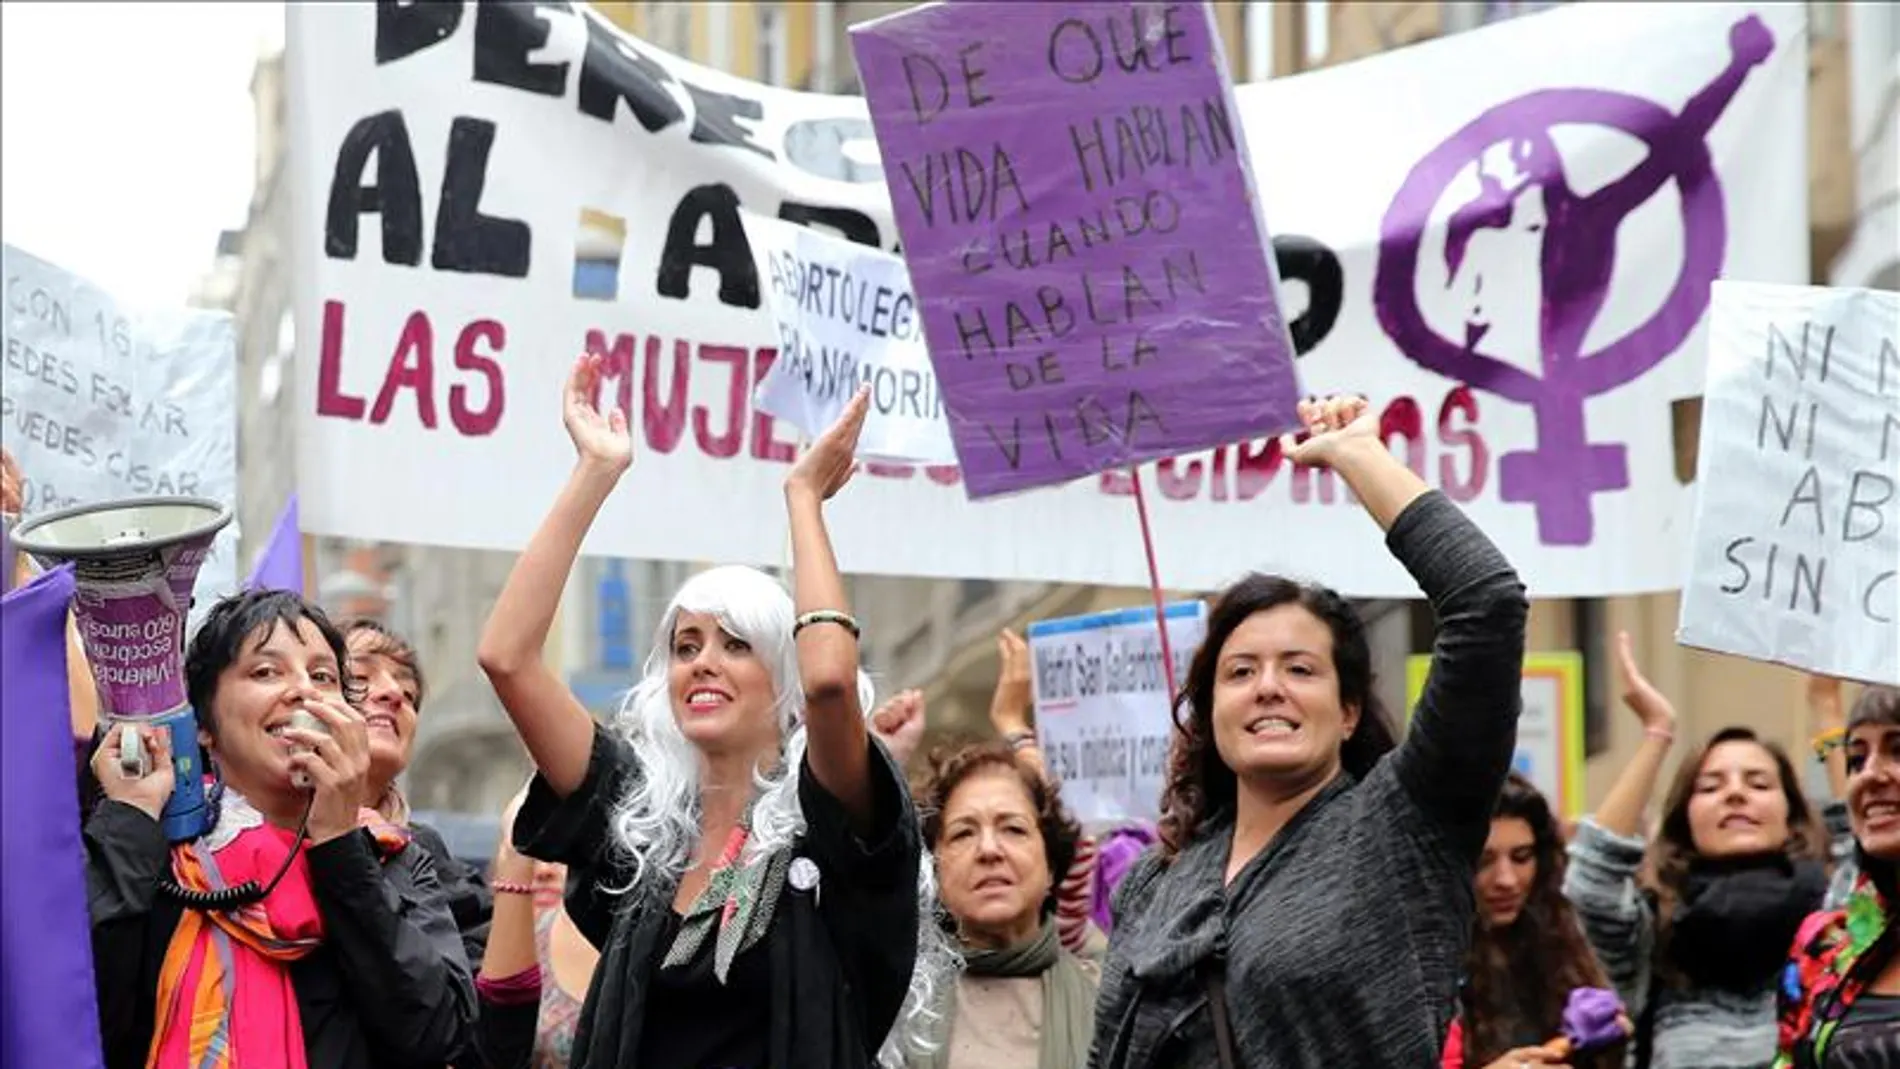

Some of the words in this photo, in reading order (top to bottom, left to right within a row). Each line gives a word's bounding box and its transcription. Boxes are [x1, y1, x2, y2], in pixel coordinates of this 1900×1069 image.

[901, 41, 996, 126] DE
[325, 108, 531, 278] AL
[900, 142, 1031, 229] VIDA
[1069, 96, 1236, 192] HABLAN
[962, 190, 1180, 274] CUANDO
[7, 276, 72, 336] CON
[95, 311, 131, 358] 16
[953, 251, 1206, 361] HABLAN
[316, 300, 506, 436] LAS
[1005, 351, 1065, 393] DE
[1102, 335, 1158, 373] LA
[1765, 321, 1836, 383] NI
[985, 389, 1170, 470] VIDA
[1757, 395, 1818, 460] NI
[1720, 537, 1826, 616] SIN
